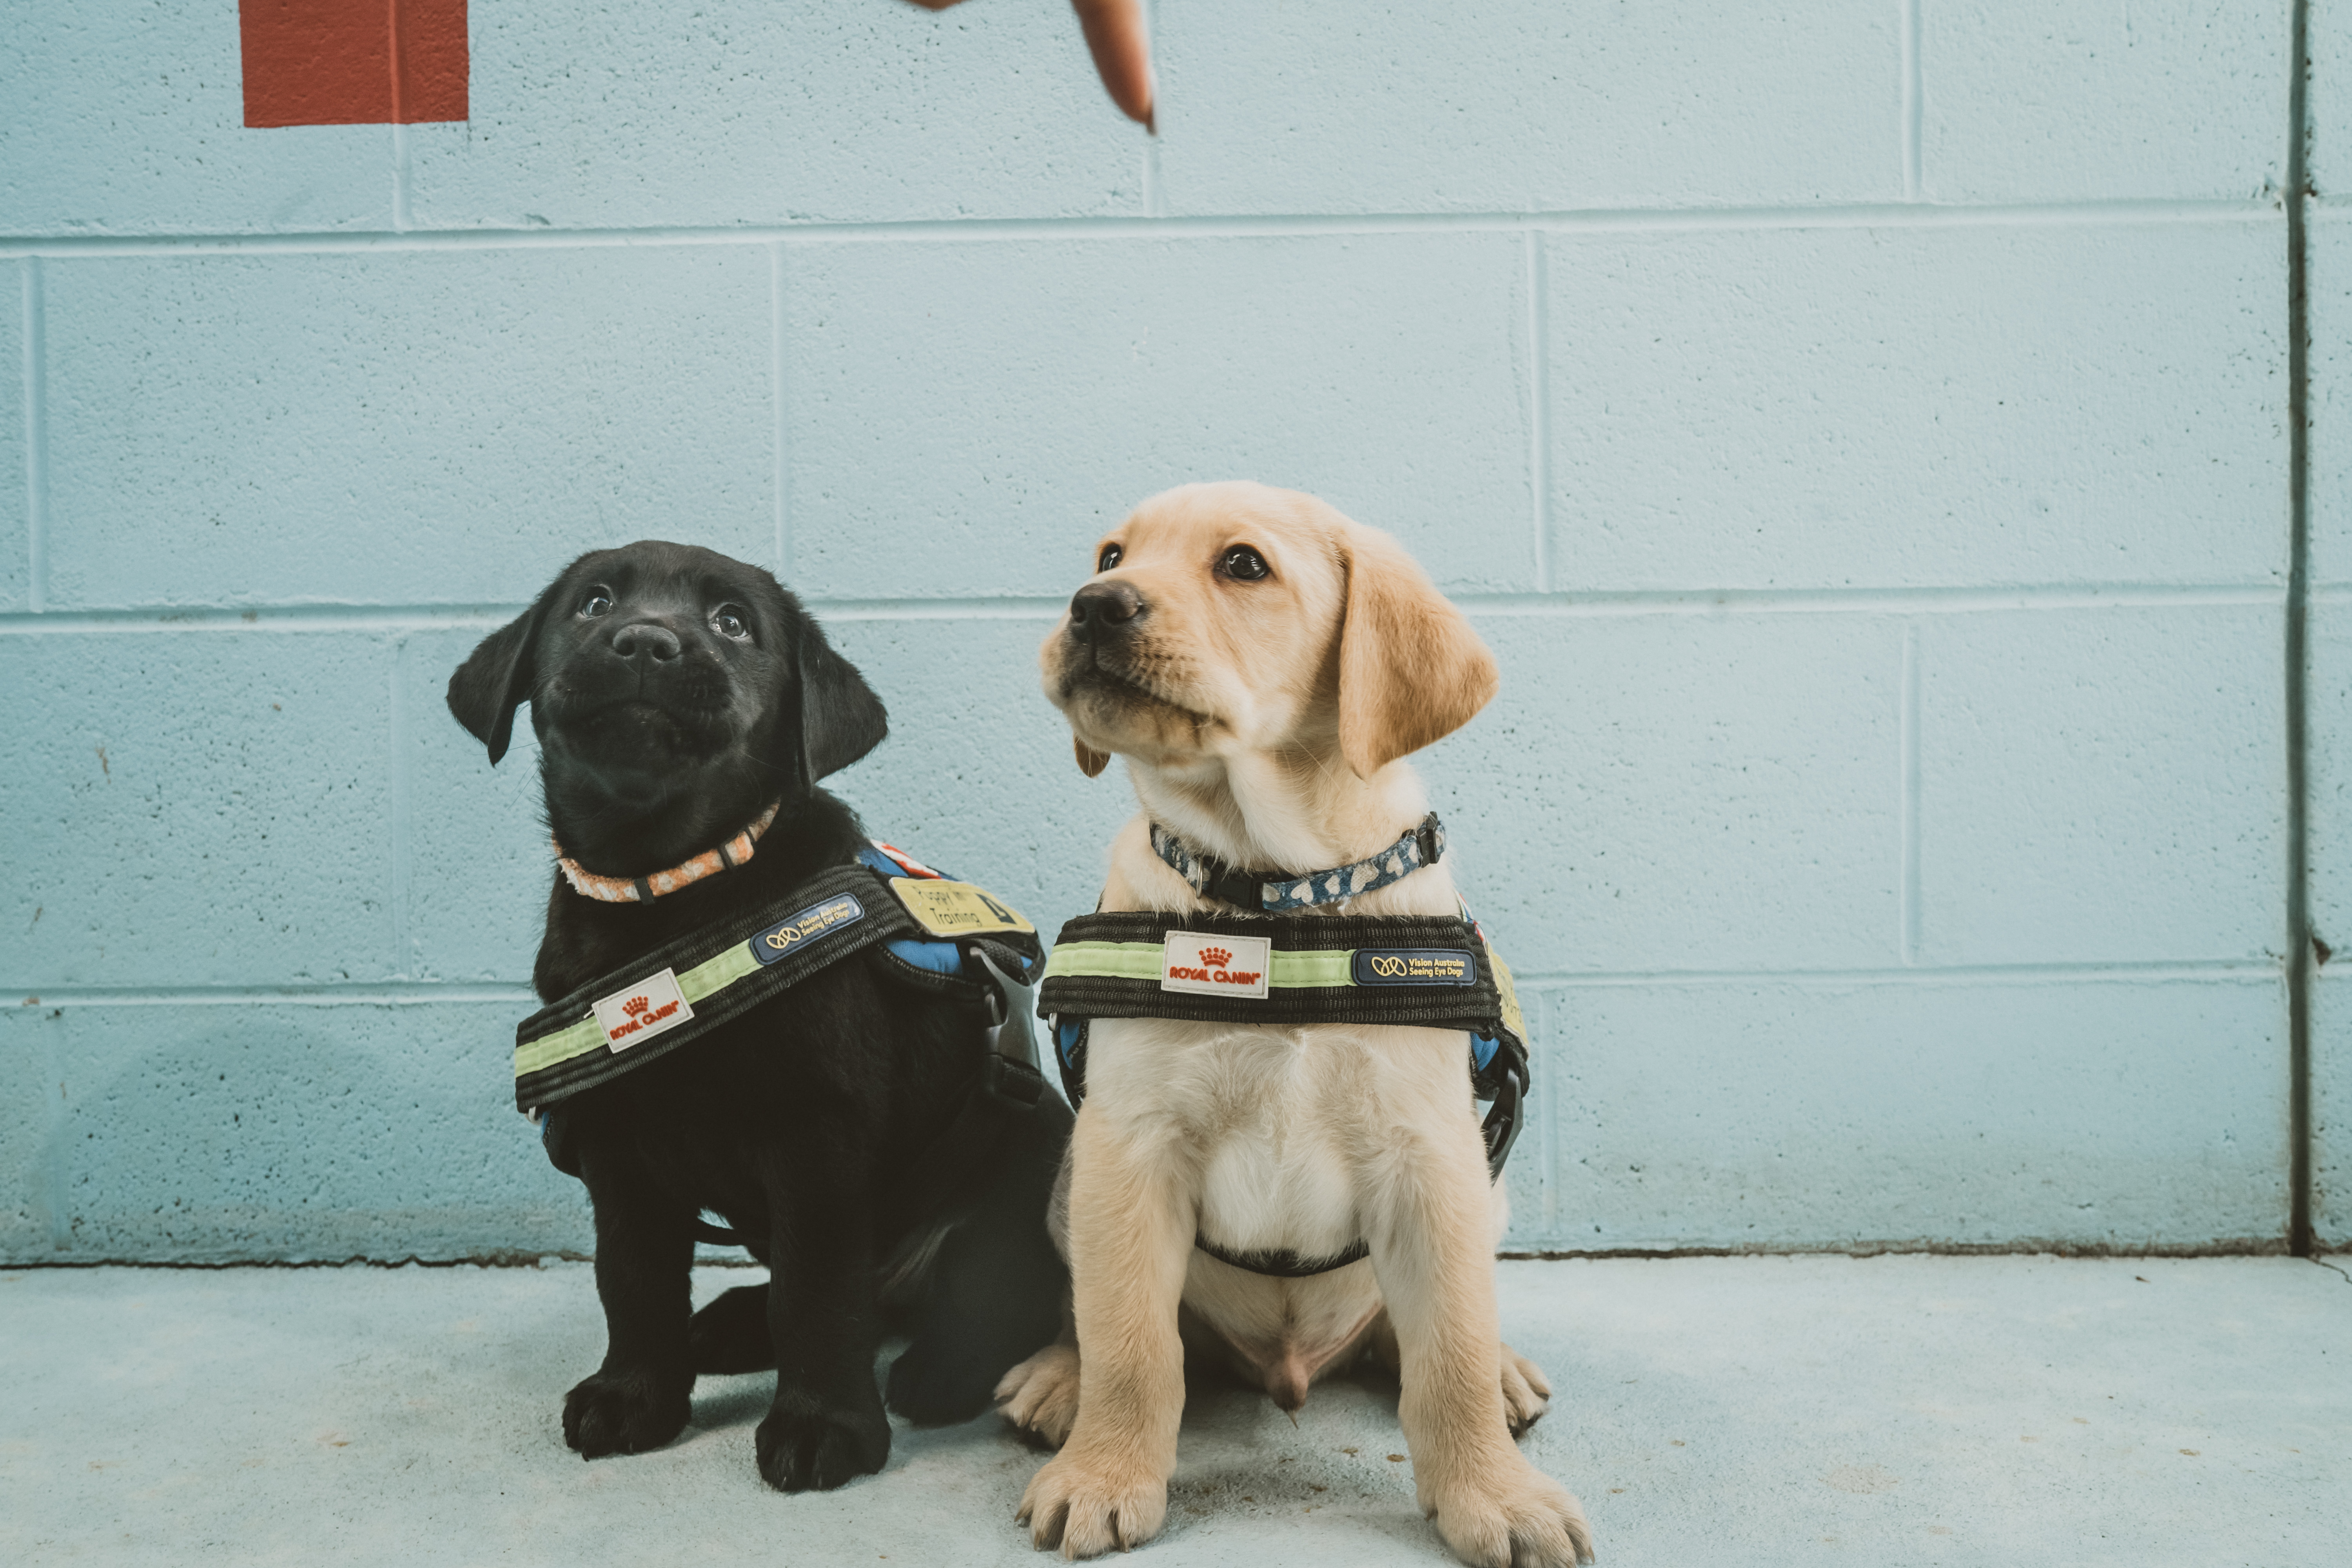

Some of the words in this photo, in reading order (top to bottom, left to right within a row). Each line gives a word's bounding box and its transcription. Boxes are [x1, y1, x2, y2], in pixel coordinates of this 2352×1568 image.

[797, 915, 820, 929] Vision
[802, 921, 824, 936] Seeing
[823, 916, 835, 925] Eye
[834, 910, 849, 920] Dogs
[929, 908, 982, 927] Training
[1408, 958, 1432, 967] Vision
[1434, 958, 1465, 967] Australia
[1169, 966, 1210, 982] ROYAL
[1409, 967, 1434, 977] Seeing
[1434, 967, 1446, 977] Eye
[1447, 967, 1463, 977] Dogs
[610, 1019, 643, 1040] ROYAL
